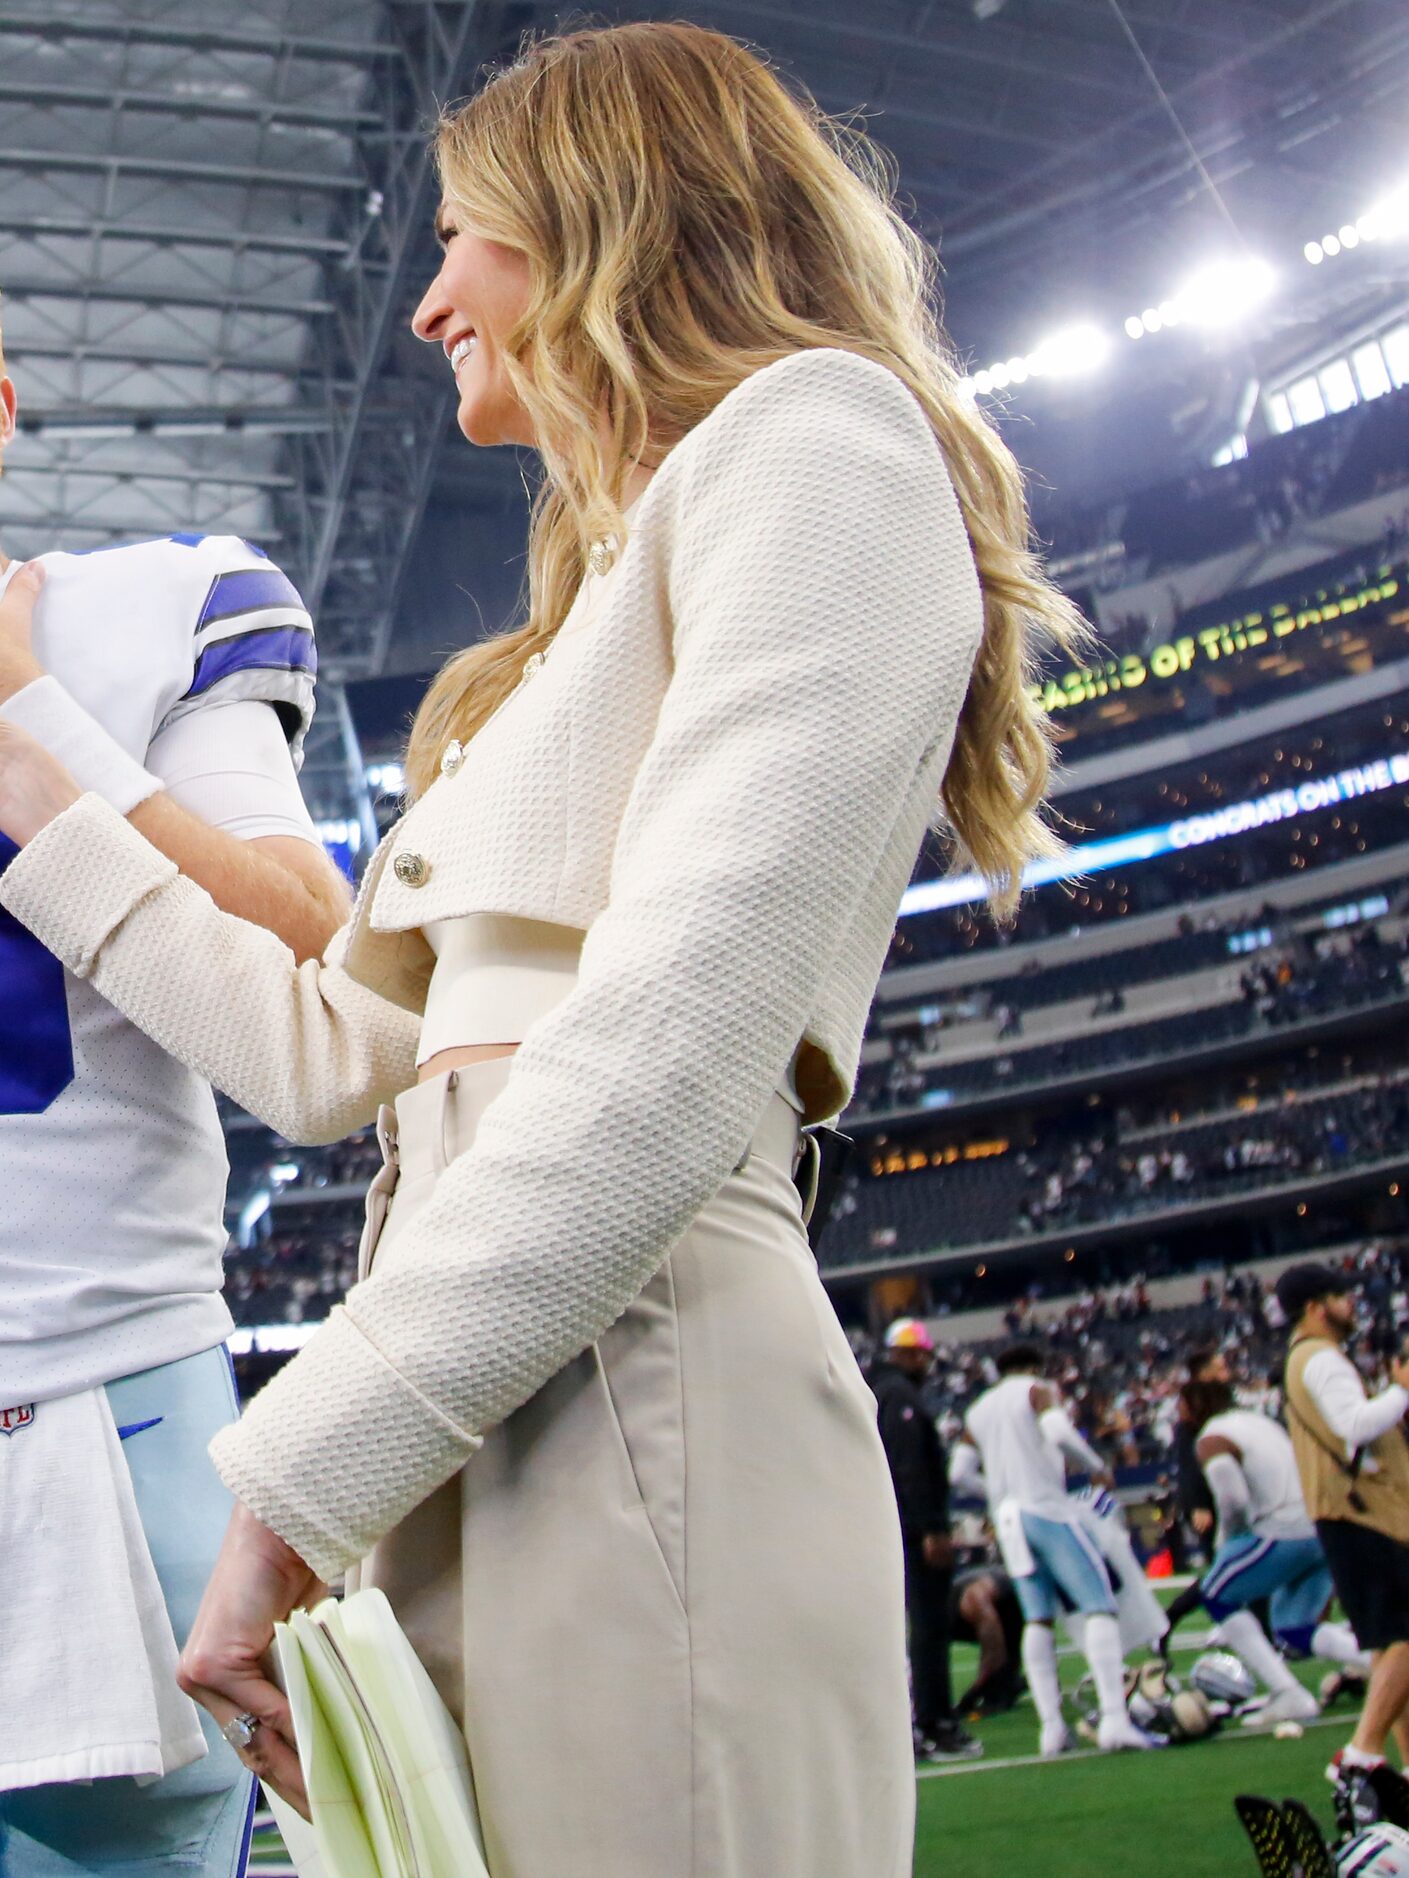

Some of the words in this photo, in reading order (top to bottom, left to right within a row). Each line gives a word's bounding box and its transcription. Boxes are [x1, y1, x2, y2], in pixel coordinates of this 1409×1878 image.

[1151, 636, 1195, 678] OF
[1168, 788, 1299, 849] CONGRATS
[1296, 774, 1341, 812] ON
[1337, 758, 1393, 799] THE
